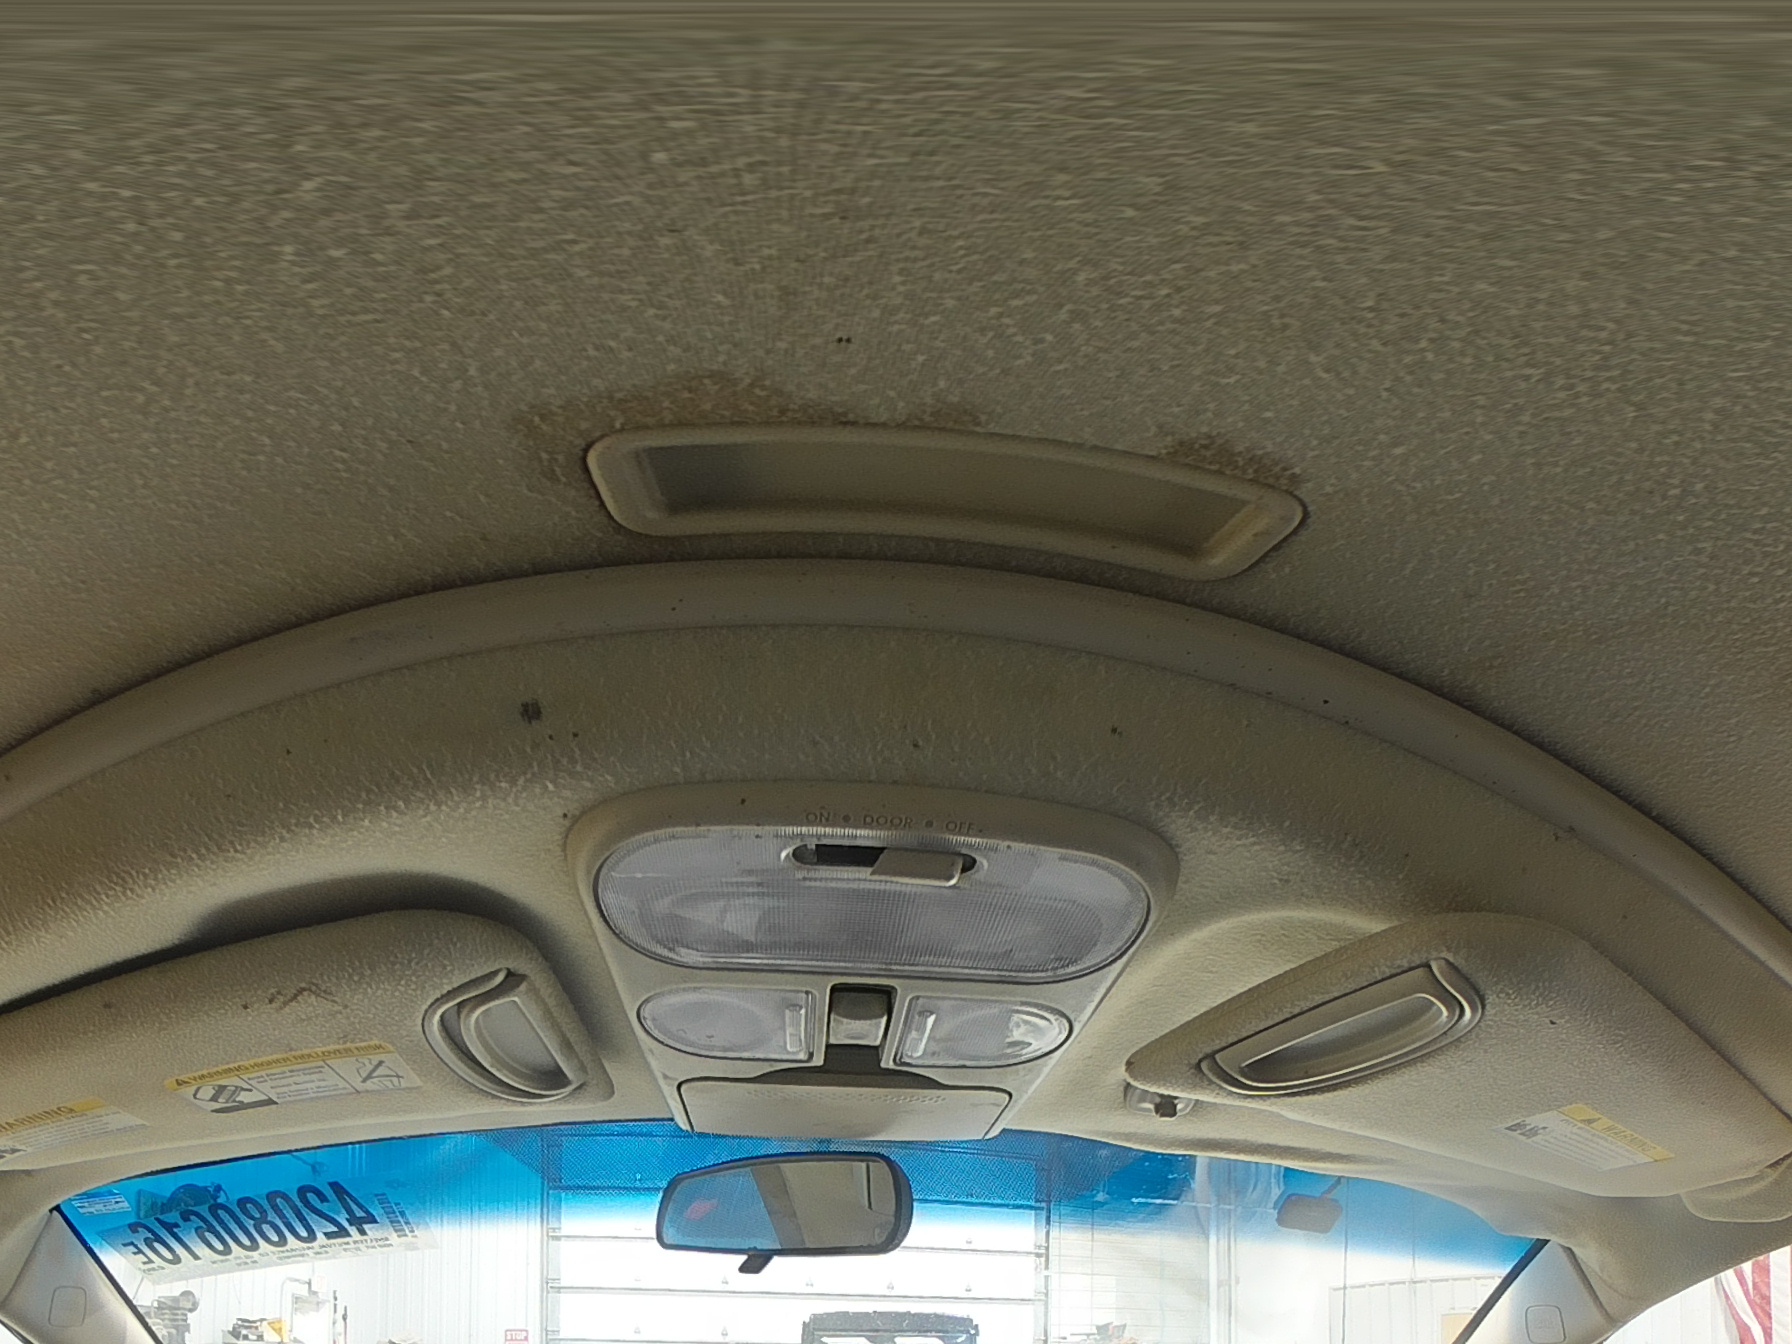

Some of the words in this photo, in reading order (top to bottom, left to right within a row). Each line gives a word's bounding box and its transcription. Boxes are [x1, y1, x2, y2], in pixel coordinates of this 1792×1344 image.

[805, 811, 831, 824] ON
[863, 814, 913, 829] DOOR
[945, 821, 975, 834] OFF
[187, 1063, 250, 1083] WARNING
[251, 1056, 292, 1071] HIGHER
[292, 1047, 354, 1062] ROLLOVER
[354, 1042, 386, 1054] RISK
[1601, 1123, 1658, 1153] WARNING
[506, 1331, 527, 1340] STOP
